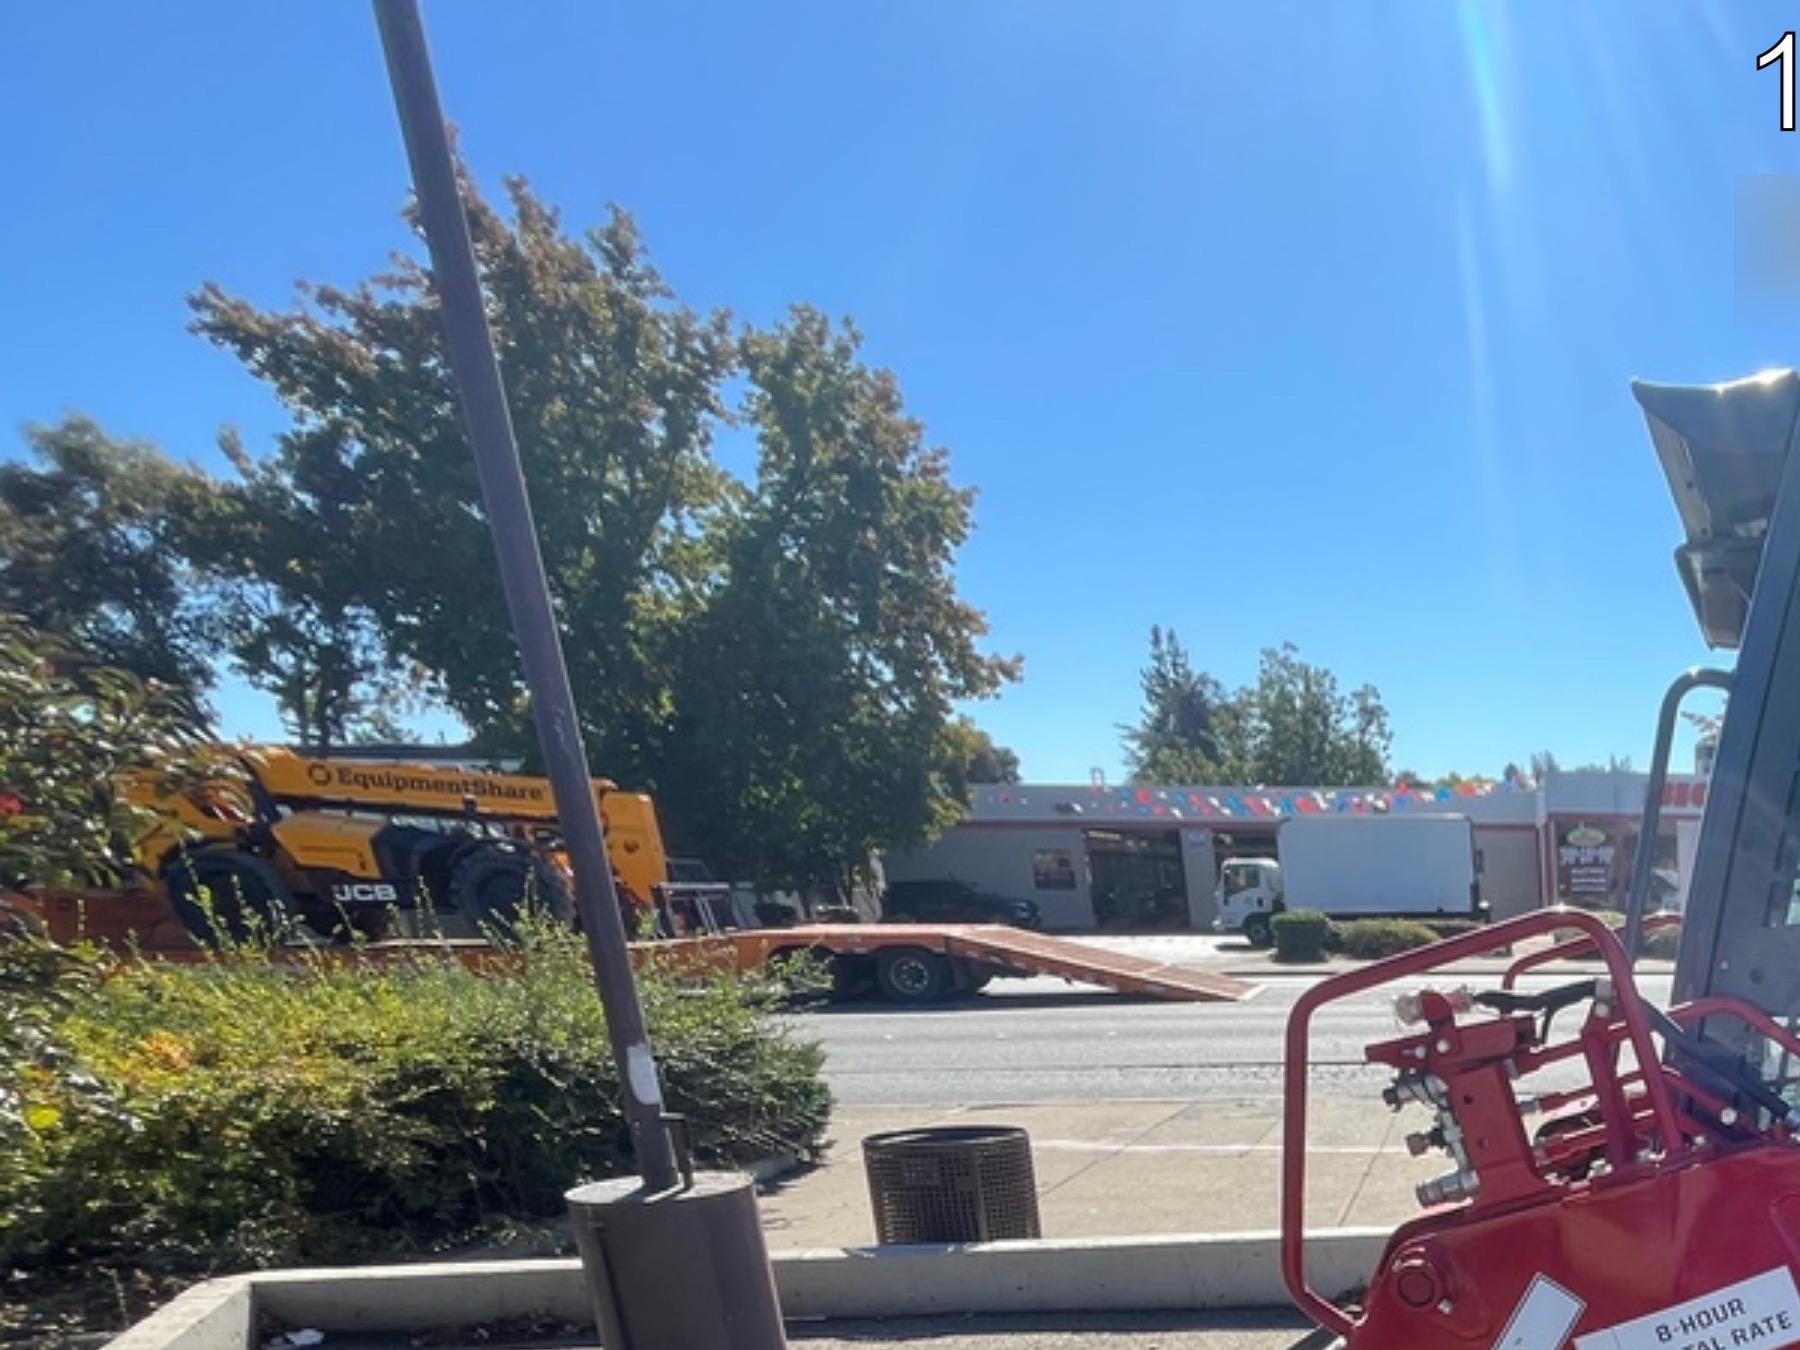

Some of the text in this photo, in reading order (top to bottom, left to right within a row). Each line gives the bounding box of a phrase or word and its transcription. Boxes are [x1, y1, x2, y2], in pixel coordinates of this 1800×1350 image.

[336, 767, 542, 799] EquipmentShare
[332, 884, 397, 901] JCB
[1655, 1298, 1747, 1343] 8-HOUR
[1730, 1311, 1793, 1346] RATE
